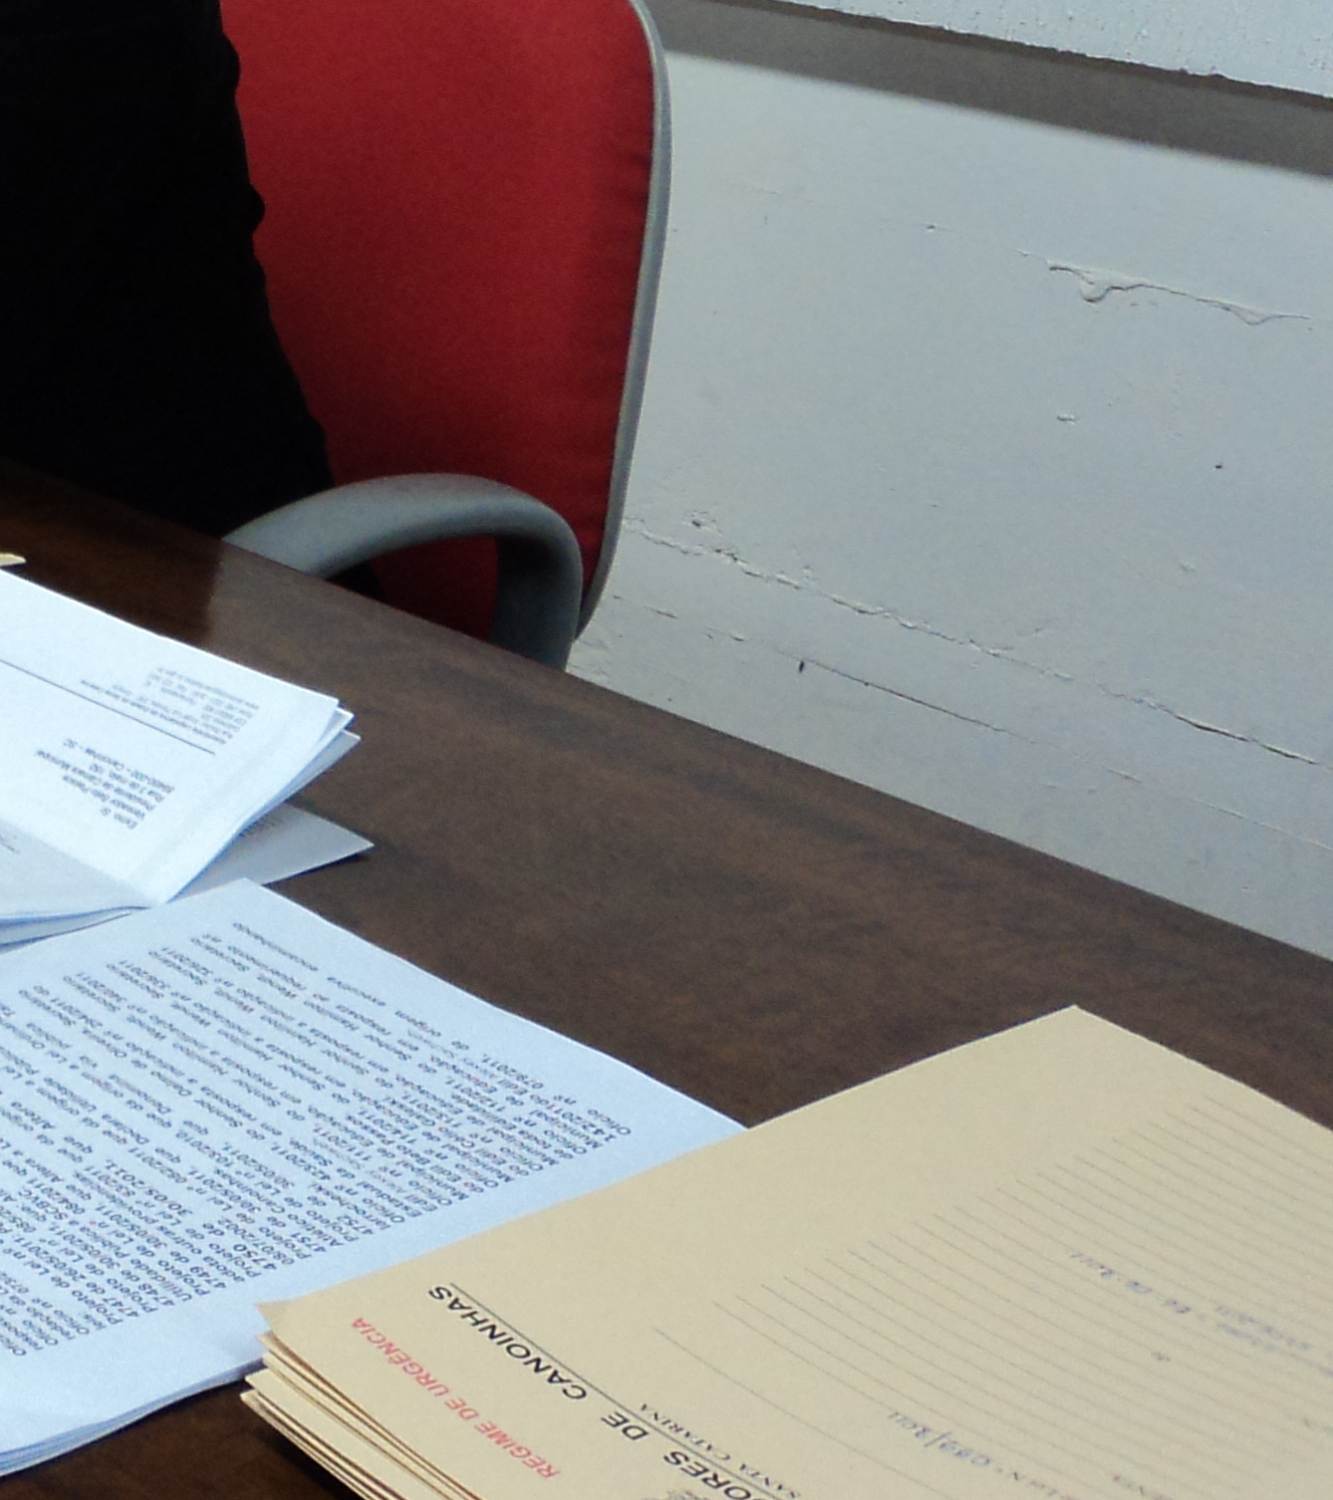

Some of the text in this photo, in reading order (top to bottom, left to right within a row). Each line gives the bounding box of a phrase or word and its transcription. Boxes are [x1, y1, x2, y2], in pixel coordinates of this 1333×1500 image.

[428, 1285, 587, 1400] CANOINHAS
[351, 1317, 560, 1480] REGIME DE URGÊNCIA
[601, 1412, 649, 1440] DE
[641, 1404, 801, 1499] SANTA CATARINA
